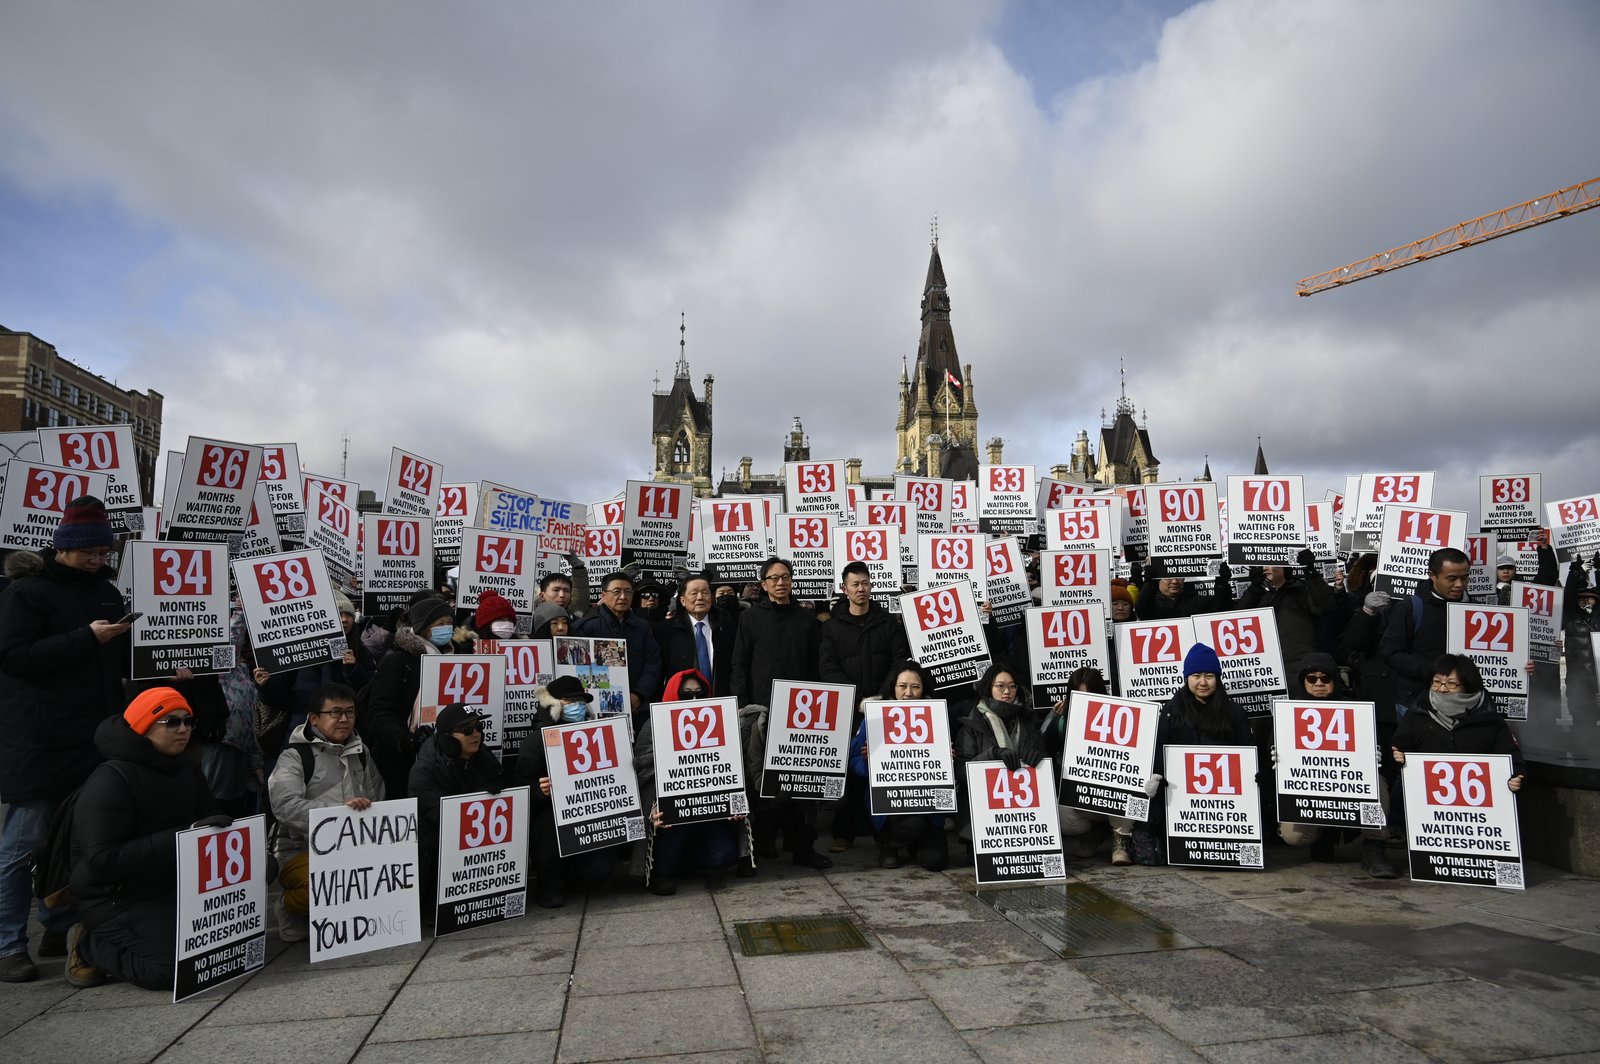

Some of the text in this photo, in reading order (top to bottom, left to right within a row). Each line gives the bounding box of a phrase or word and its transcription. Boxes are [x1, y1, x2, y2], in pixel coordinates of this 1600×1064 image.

[66, 432, 112, 470] 30
[203, 446, 243, 487] 36
[403, 459, 428, 493] 42
[798, 464, 830, 492] 53
[991, 468, 1022, 491] 33
[1377, 476, 1417, 501] 35
[1496, 478, 1525, 501] 38
[198, 491, 234, 502] MONTHS
[497, 493, 571, 519] STOP THE
[643, 487, 672, 517] 11
[912, 483, 938, 510] 68
[1164, 489, 1199, 520] 90
[1248, 481, 1284, 509] 70
[177, 513, 243, 525] IRCC RESPONSE
[186, 502, 240, 514] WAITING FOR
[319, 496, 348, 533] 20
[717, 503, 748, 530] 71
[1562, 499, 1595, 523] 32
[382, 521, 415, 554] 40
[794, 518, 823, 546] 53
[1064, 511, 1096, 539] 55
[1167, 524, 1201, 532] MONTHS
[1405, 512, 1441, 545] 11
[539, 535, 585, 553] TOGETHER
[589, 530, 616, 556] 39
[851, 531, 882, 560] 63
[1158, 534, 1192, 542] WAITING
[1174, 543, 1216, 551] RESPONSE
[481, 536, 518, 572] 54
[936, 539, 968, 567] 68
[160, 550, 206, 594] 34
[261, 559, 308, 600] 38
[1059, 554, 1092, 585] 34
[160, 601, 205, 611] MONTHS
[269, 600, 312, 615] MONTHS
[920, 590, 957, 628] 39
[1526, 588, 1549, 615] 31
[147, 614, 216, 625] WAITING FOR
[258, 619, 335, 642] IRCC RESPONSE
[261, 609, 326, 629] WAITING FOR
[1048, 610, 1085, 645] 40
[1470, 612, 1508, 650] 22
[140, 627, 223, 640] IRCC RESPONSE
[1135, 626, 1175, 662] 72
[1217, 617, 1257, 654] 65
[152, 647, 212, 658] NO TIMELINES
[272, 638, 329, 655] NO TIMELINES
[278, 648, 327, 664] NO RESULTS
[156, 658, 208, 669] NO RESULTS
[444, 664, 484, 703] 42
[793, 689, 829, 729] 81
[677, 706, 718, 748] 62
[888, 706, 928, 743] 35
[1090, 703, 1133, 744] 40
[1300, 709, 1349, 750] 34
[570, 727, 612, 772] 31
[678, 752, 719, 764] MONTHS
[1302, 756, 1349, 766] MONTHS
[574, 774, 614, 789] MONTHS
[663, 774, 737, 791] IRCC RESPONSE
[668, 763, 731, 778] WAITING FOR
[1193, 754, 1235, 793] 51
[1290, 767, 1362, 780] WAITING FOR
[565, 785, 626, 804] WAITING FOR
[993, 768, 1033, 807] 43
[1284, 780, 1370, 793] IRCC RESPONSE
[1431, 762, 1485, 805] 36
[562, 796, 634, 819] IRCC RESPONSE
[674, 793, 728, 806] NO TIMELINES
[679, 804, 726, 816] NO RESULTS
[1310, 800, 1358, 810] TIMELINES
[465, 798, 507, 847] 36
[574, 816, 627, 834] NO TIMELINES
[994, 812, 1035, 822] MONTHS
[1300, 809, 1355, 820] NO RESULTS
[1434, 811, 1486, 822] MONTHS
[311, 813, 418, 855] CANADA
[579, 827, 625, 844] NO RESULTS
[981, 836, 1054, 848] IRCC RESPONSE
[985, 824, 1047, 835] WAITING FOR
[1421, 823, 1501, 837] WAITING FOR
[1416, 836, 1510, 850] IRCC RESPONSE
[205, 830, 244, 890] 18
[464, 849, 505, 866] MONTHS
[452, 861, 515, 881] WAITING FOR
[311, 863, 414, 906] WHAT ARE
[445, 873, 520, 897] IRCC RESPONSE
[204, 888, 245, 911] MONTHS
[192, 901, 254, 932] WAITING FOR
[185, 915, 259, 951] IRCC RESPONSE
[312, 910, 407, 952] YOU DOING
